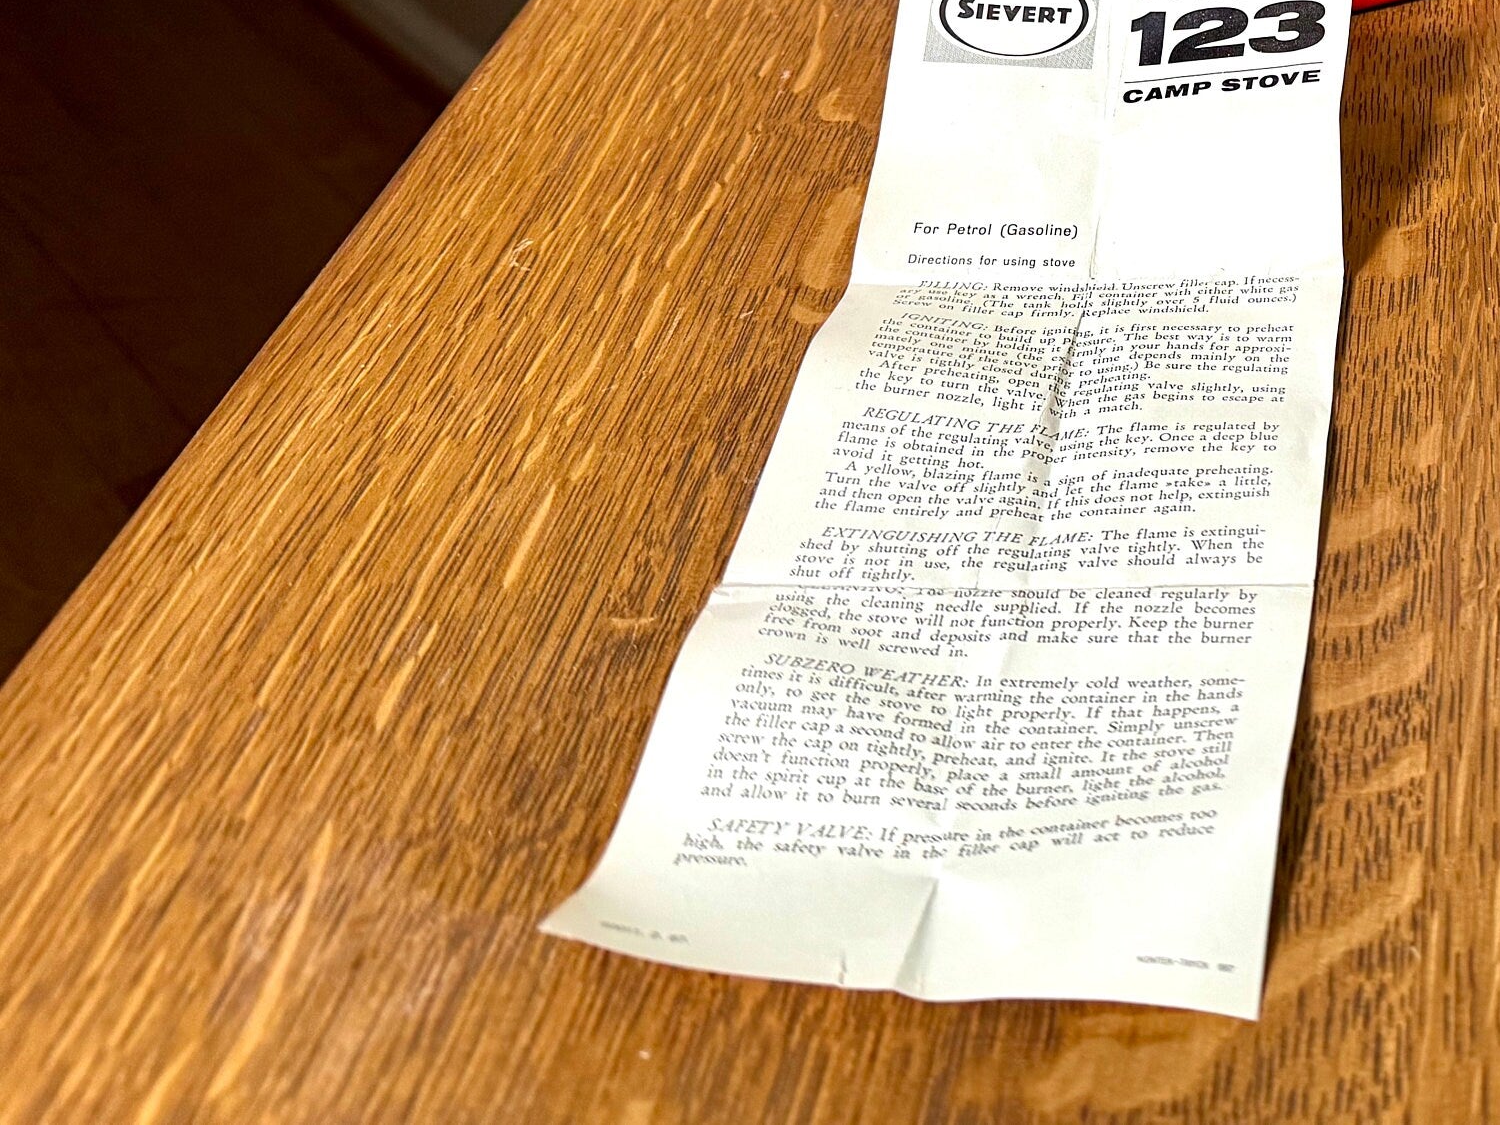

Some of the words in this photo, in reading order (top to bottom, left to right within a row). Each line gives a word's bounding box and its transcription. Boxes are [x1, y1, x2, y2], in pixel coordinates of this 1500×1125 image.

[1130, 0, 1325, 67] 123
[1122, 80, 1212, 104] CAMP
[1221, 69, 1322, 92] STOVE
[914, 222, 939, 234] For
[947, 223, 992, 235] Petrol
[1000, 223, 1078, 240] (Gasoline)
[908, 254, 972, 265] Directions
[980, 255, 997, 265] for
[1003, 257, 1036, 269] using
[1043, 258, 1075, 267] stove
[918, 294, 974, 305] gasoline.
[983, 300, 1014, 308] (The
[1101, 299, 1148, 307] slightly
[1209, 295, 1239, 304] fluid
[1247, 293, 1296, 303] ounces.)
[962, 305, 994, 315] filler
[1031, 309, 1074, 318] firmly.
[1082, 307, 1130, 318] Replace
[1138, 304, 1208, 313] windshield.
[900, 312, 989, 331] IGNITING:
[994, 325, 1037, 335] Before
[1042, 325, 1094, 339] igniting,
[1100, 326, 1109, 334] it
[1115, 325, 1124, 333] is
[1131, 323, 1157, 331] first
[1162, 325, 1222, 333] necessary
[1246, 324, 1294, 334] preheat
[860, 368, 880, 379] the
[888, 371, 913, 385] key
[941, 381, 969, 390] turn
[978, 383, 999, 394] the
[1007, 388, 1046, 401] valve.
[1054, 395, 1090, 408] When
[1098, 394, 1118, 403] the
[1124, 393, 1145, 402] gas
[1153, 390, 1194, 402] begins
[862, 406, 981, 431] REGULATING
[987, 422, 1025, 433] THE
[1030, 424, 1089, 442] FLAME:
[1097, 424, 1123, 435] The
[1130, 422, 1168, 432] flame
[1175, 422, 1185, 431] is
[1193, 421, 1256, 432] regulated
[1263, 421, 1279, 432] by
[837, 430, 878, 446] flame
[885, 436, 896, 448] is
[903, 441, 964, 456] obtained
[971, 446, 984, 456] in
[1021, 449, 1066, 465] proper
[1073, 446, 1136, 460] intensity,
[1202, 442, 1223, 452] the
[1231, 442, 1255, 453] key
[842, 421, 885, 433] means
[890, 424, 907, 435] of
[911, 426, 932, 438] the
[937, 433, 1008, 448] regulating
[1015, 435, 1053, 453] valve,
[1060, 440, 1094, 453] using
[1099, 436, 1120, 446] the
[1125, 434, 1153, 445] key.
[1159, 433, 1194, 441] Once
[1213, 431, 1244, 442] deep
[1250, 431, 1278, 440] blue
[833, 447, 874, 459] avoid
[881, 450, 893, 461] it
[900, 455, 950, 470] getting
[958, 457, 984, 469] hot.
[845, 461, 856, 471] A
[864, 463, 916, 479] yellow,
[923, 468, 975, 484] blazing
[982, 470, 1021, 480] flame
[1027, 471, 1038, 483] is
[1058, 475, 1084, 486] sign
[1091, 470, 1108, 481] of
[1113, 467, 1189, 479] inadequate
[1195, 464, 1273, 478] preheating.
[822, 526, 978, 543] EXTINGUISHING
[984, 531, 1023, 544] THE
[1028, 532, 1093, 547] FLAME:
[1101, 529, 1129, 540] The
[1136, 528, 1177, 539] flame
[1184, 526, 1194, 537] is
[1201, 524, 1266, 539] extingui-
[789, 565, 821, 578] shut
[829, 566, 854, 578] off
[862, 568, 915, 583] tightly.
[776, 591, 815, 606] using
[826, 593, 850, 606] the
[861, 595, 924, 613] cleaning
[935, 600, 983, 612] needle
[993, 602, 1061, 616] supplied.
[1075, 601, 1090, 613] If
[1100, 601, 1123, 614] the
[1134, 601, 1183, 613] nozzle
[1194, 600, 1256, 615] becomes
[763, 652, 856, 675] SUBZERO
[864, 666, 969, 688] WEATHER:
[977, 675, 992, 687] In
[1000, 677, 1079, 693] extremely
[1086, 676, 1119, 689] cold
[1127, 676, 1192, 688] weather,
[1200, 678, 1245, 686] some-
